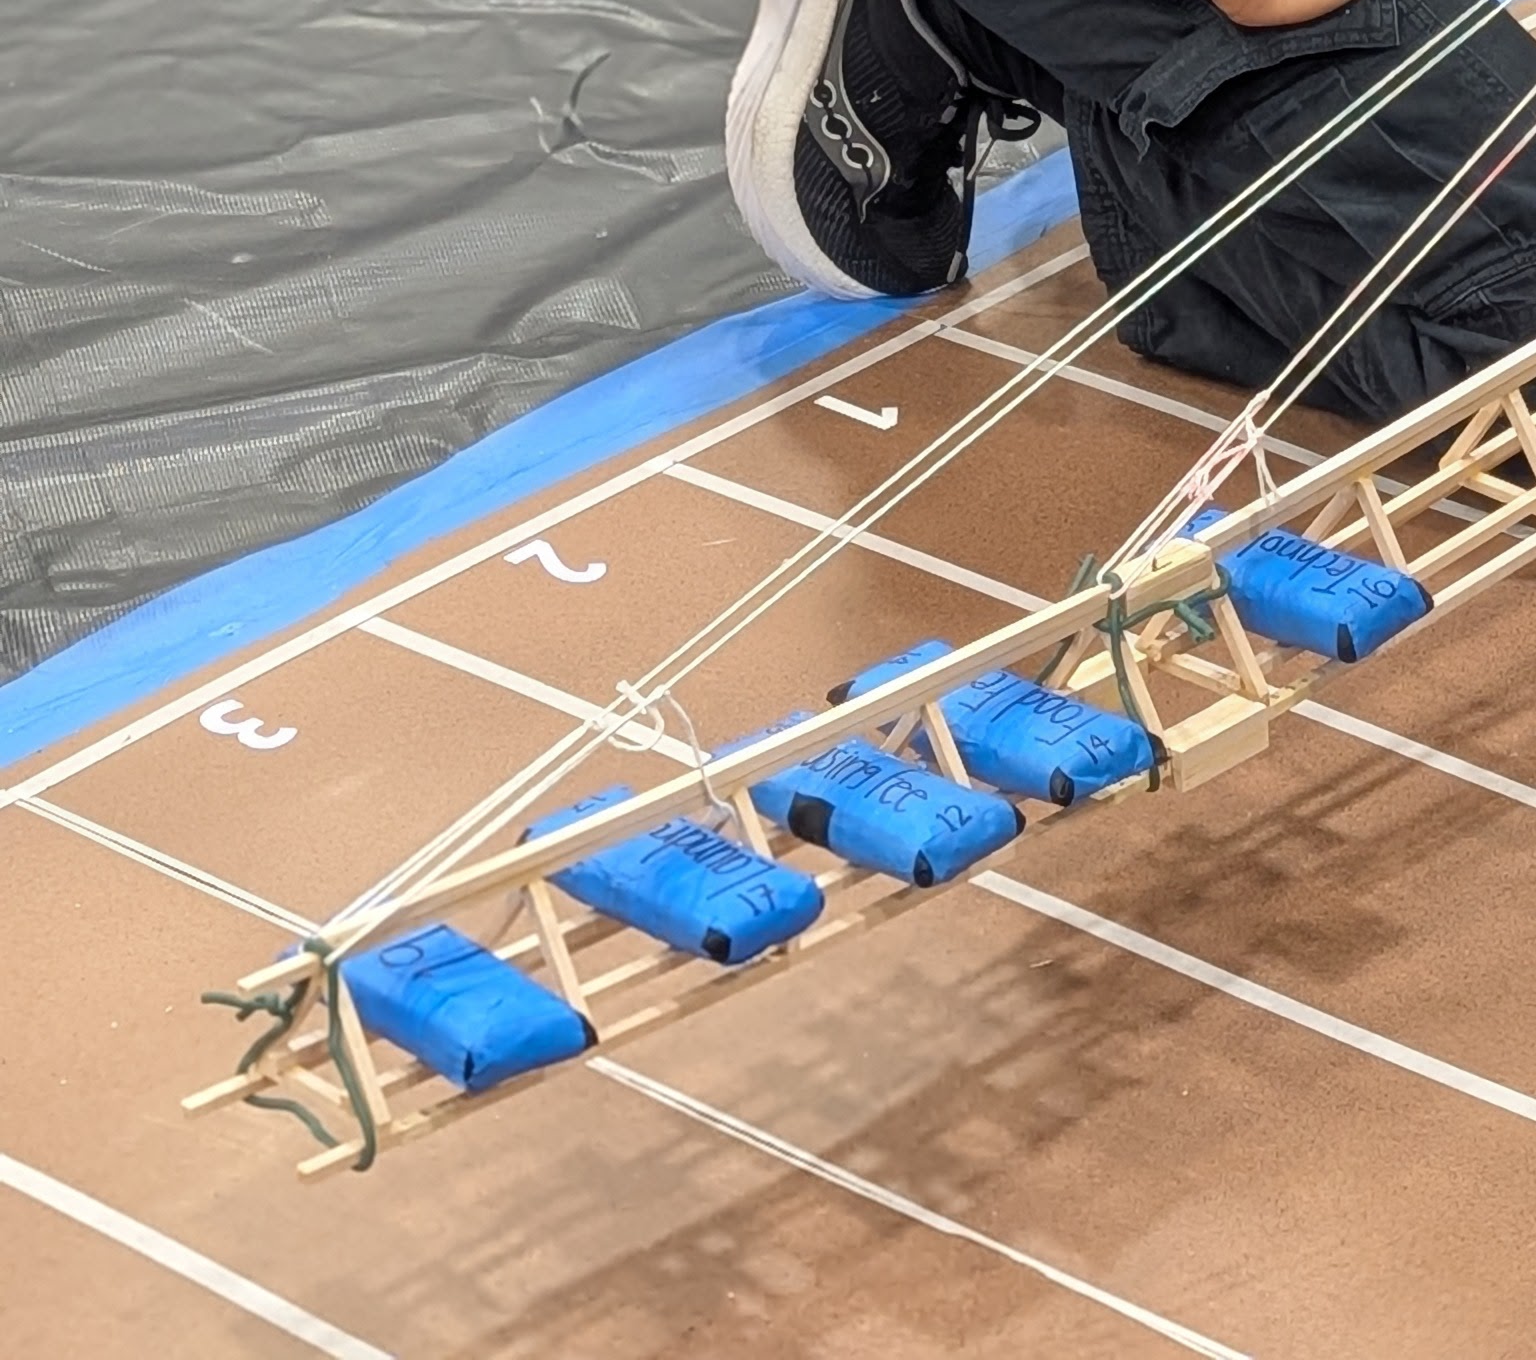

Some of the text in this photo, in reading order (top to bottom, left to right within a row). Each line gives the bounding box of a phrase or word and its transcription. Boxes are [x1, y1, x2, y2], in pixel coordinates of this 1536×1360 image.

[502, 538, 608, 584] 2
[199, 698, 298, 750] 3
[1075, 732, 1115, 766] 14
[935, 803, 973, 832] 12
[735, 882, 776, 917] 17
